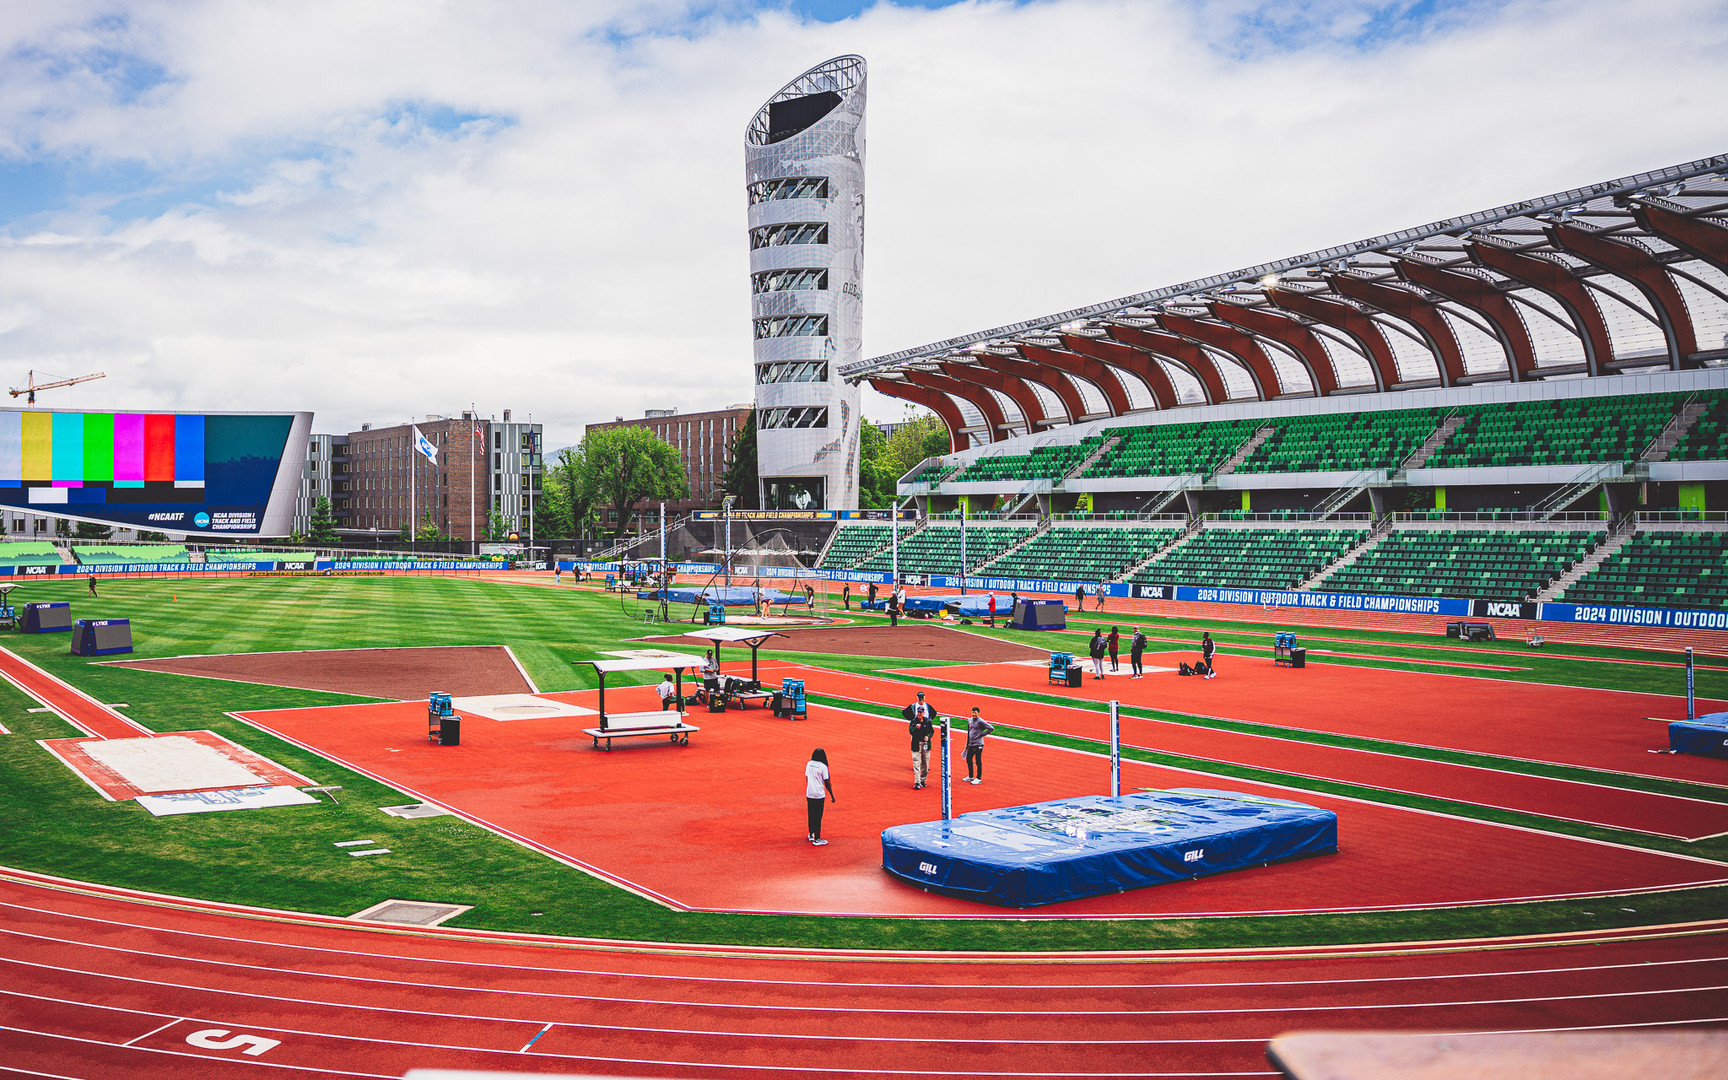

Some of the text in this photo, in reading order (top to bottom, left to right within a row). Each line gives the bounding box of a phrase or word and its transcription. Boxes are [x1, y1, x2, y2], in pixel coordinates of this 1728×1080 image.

[148, 512, 185, 521] #NCAATF
[25, 566, 46, 575] NCAA
[76, 564, 94, 573] 2024
[94, 564, 123, 573] DIVISION
[128, 564, 158, 572] OUTDOOR
[159, 563, 180, 571] TRACK
[180, 563, 185, 571] &
[186, 563, 203, 571] FIELD
[204, 562, 256, 571] CHAMPIONSHIPS
[284, 562, 305, 570] NCAA
[334, 562, 350, 570] 2024
[352, 562, 378, 570] DIVISION
[384, 562, 412, 570] OUTDOOR
[413, 562, 432, 570] TRACK
[432, 562, 437, 570] &
[438, 562, 455, 570] FIELD
[455, 562, 503, 570] CHAMPIONSHIPS
[676, 563, 715, 572] CHAMPIONSHIPS
[734, 566, 748, 575] NCAA
[765, 567, 777, 576] 2024
[777, 567, 795, 577] DIVISION
[836, 570, 848, 580] FIELD
[848, 571, 884, 582] CHAMPIONSHIPS
[905, 574, 922, 584] NCAA
[945, 576, 960, 586] 2024
[988, 579, 1015, 590] OUTDOOR
[1016, 580, 1034, 591] TRACK
[1035, 580, 1040, 591] &
[1041, 581, 1058, 592] FIELD
[1140, 586, 1163, 598] NCAA
[1197, 589, 1440, 613] 2024 DIVISION I OUTDOOR TRACK & FIELD CHAMPIONSHIPS
[1486, 602, 1521, 617] NCAA
[1574, 606, 1607, 622] 2024
[1609, 607, 1663, 625] DIVISION
[1665, 611, 1671, 625] I
[1184, 849, 1204, 862] GILL
[919, 861, 938, 875] GILL
[185, 1028, 282, 1057] 5
